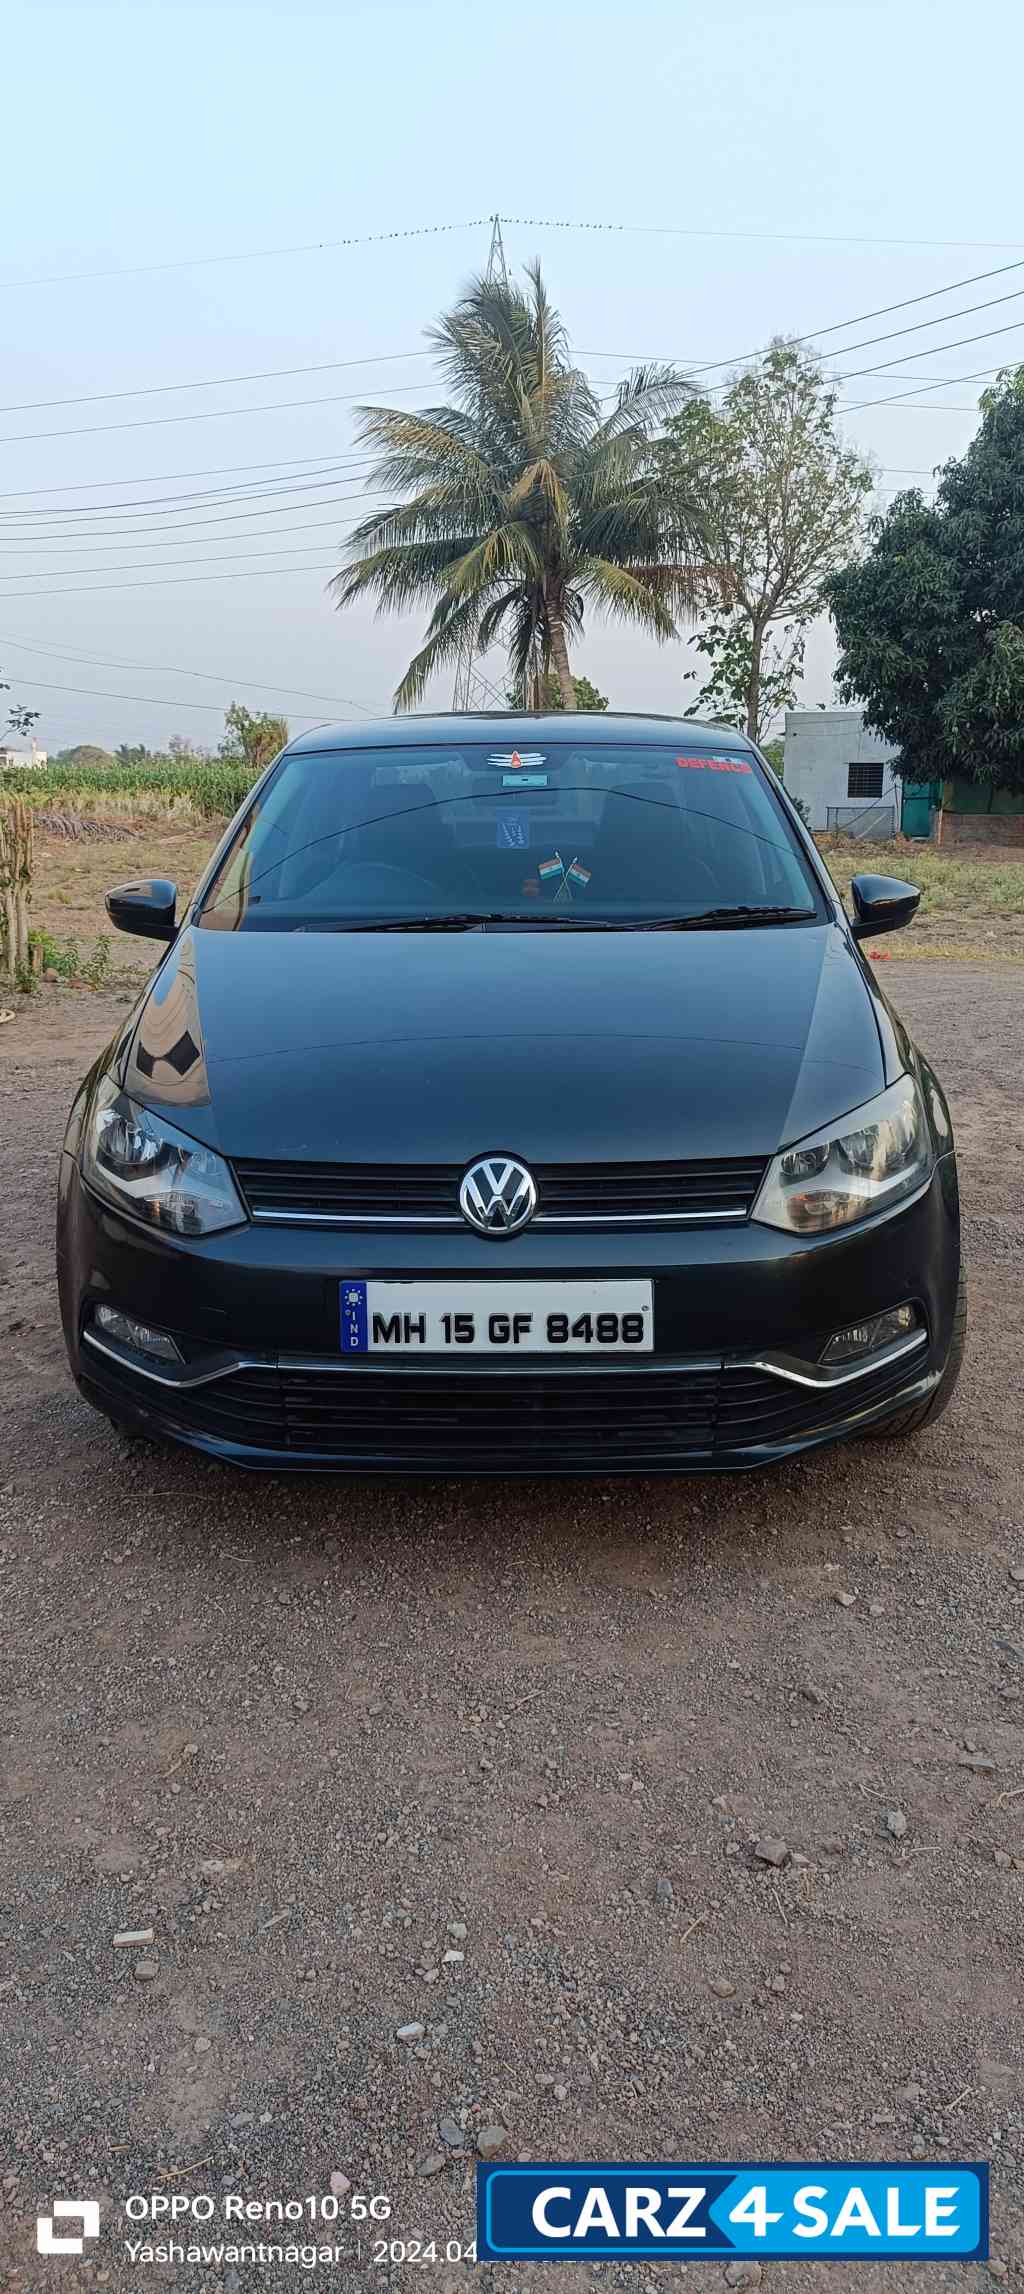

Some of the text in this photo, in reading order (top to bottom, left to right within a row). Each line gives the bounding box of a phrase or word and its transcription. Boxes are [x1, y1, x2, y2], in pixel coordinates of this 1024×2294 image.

[350, 1311, 359, 1346] IND
[372, 1312, 645, 1344] MH 15 GF 8488
